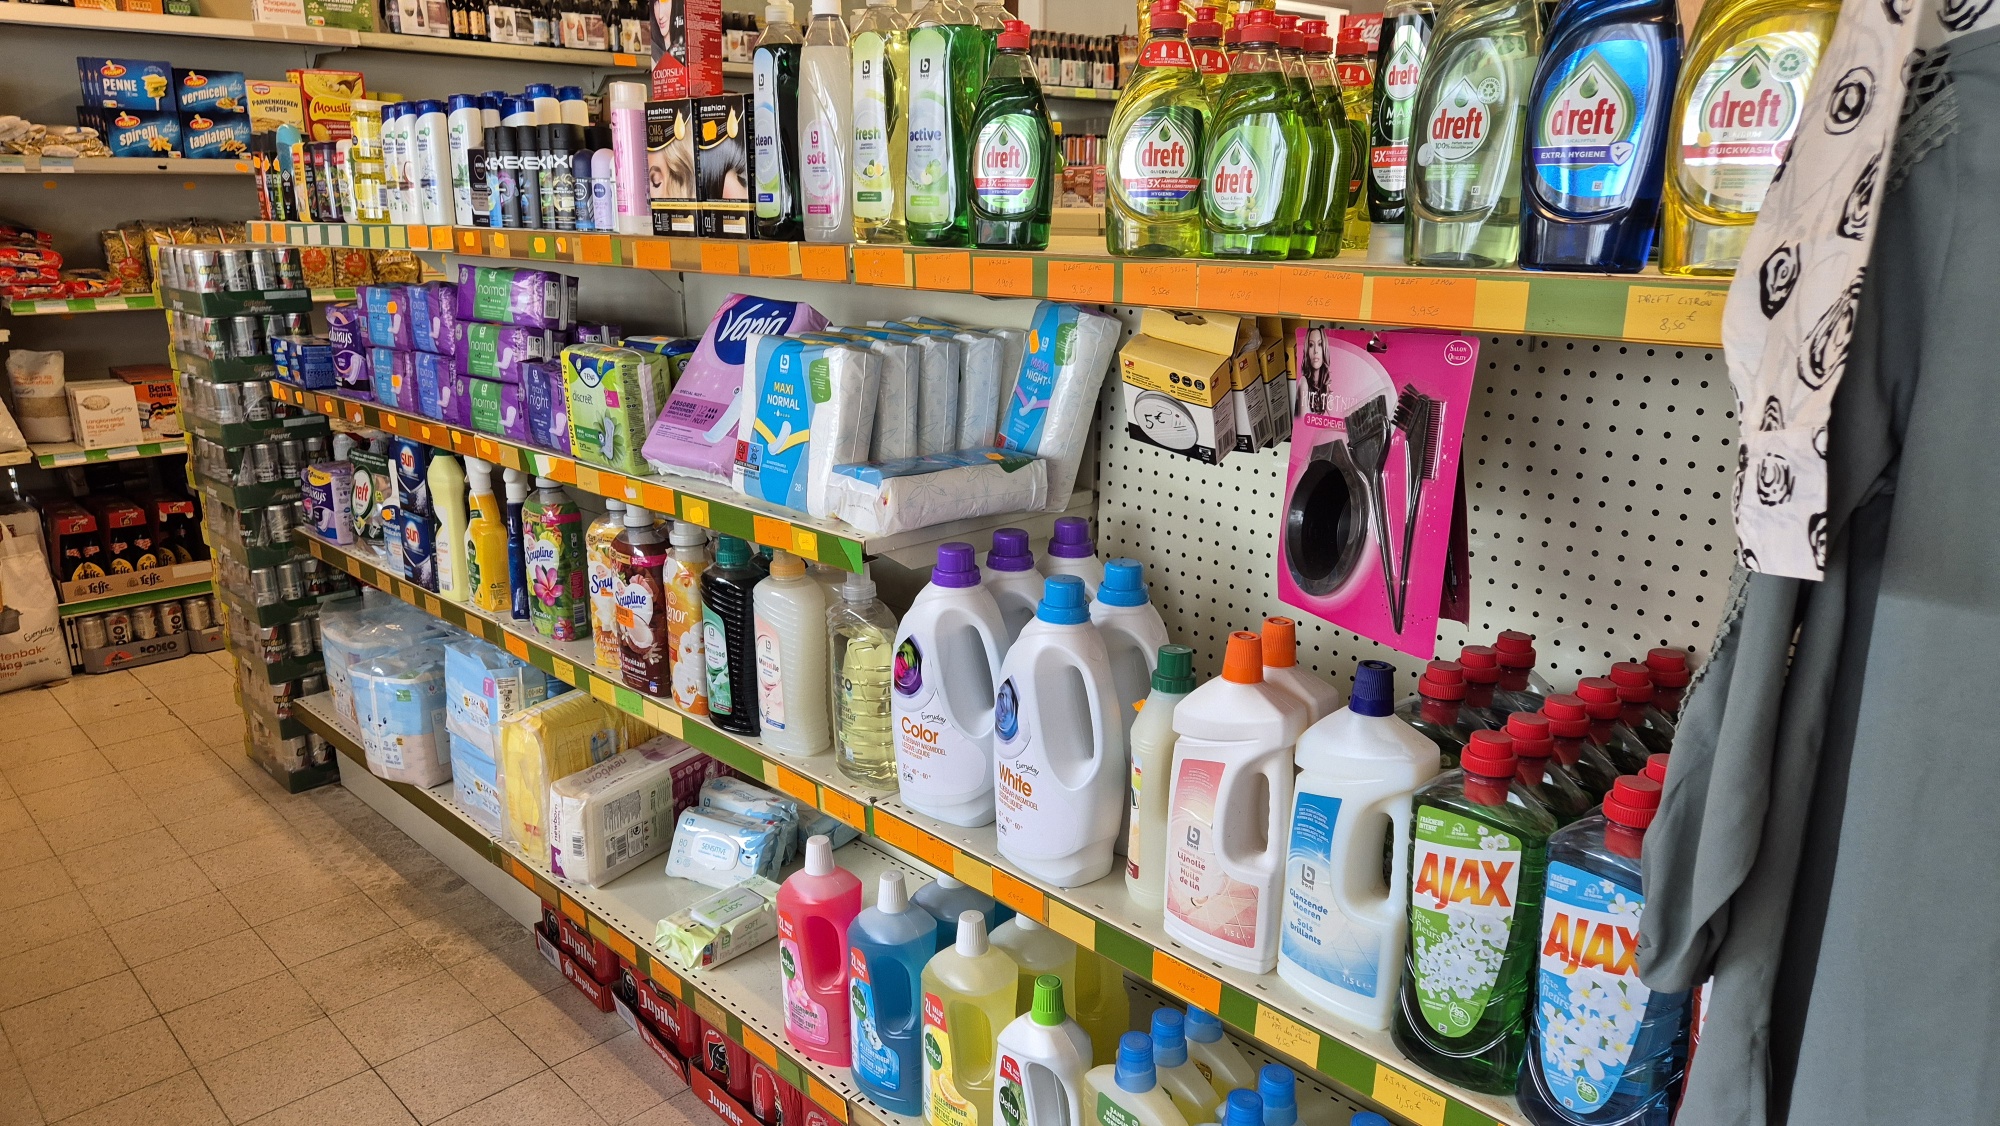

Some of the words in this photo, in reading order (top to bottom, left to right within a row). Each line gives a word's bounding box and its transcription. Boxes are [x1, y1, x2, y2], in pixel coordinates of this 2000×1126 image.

[654, 67, 684, 79] COLORSILK
[1388, 64, 1418, 86] dreft
[103, 78, 138, 92] PENNE
[182, 85, 228, 105] vermicelli
[252, 99, 299, 109] PANNENKOEKEN
[647, 107, 673, 116] fashion
[700, 104, 726, 113] fashion
[1709, 89, 1782, 129] dreft
[1432, 107, 1483, 140] dreft
[1551, 98, 1616, 136] dreft
[119, 125, 159, 147] spirelli
[855, 127, 881, 140] fresh
[910, 128, 942, 141] active
[807, 151, 827, 165] soft
[987, 145, 1021, 169] dreft
[1142, 141, 1185, 167] dreft
[1374, 150, 1386, 162] 5X
[1541, 151, 1566, 159] EXTRA
[1708, 147, 1772, 155] QUICKWASH
[1147, 179, 1162, 188] 3X
[1215, 166, 1253, 193] dreft
[1292, 268, 1318, 277] DREFT
[478, 283, 507, 297] normal
[1394, 278, 1422, 286] DREFT
[1307, 296, 1332, 307] 6,95€
[1637, 294, 1674, 303] DREFT
[1410, 306, 1440, 317] 3,95€
[717, 303, 789, 343] Vania
[471, 340, 495, 353] normal
[1030, 357, 1050, 373] MAXI
[583, 373, 596, 381] TENA
[1025, 369, 1048, 385] NIGHT
[148, 384, 172, 392] Ben's
[773, 382, 794, 395] MAXI
[473, 397, 498, 410] normal
[530, 394, 549, 410] night
[573, 390, 594, 405] discreet
[672, 400, 697, 410] ABSORBE
[766, 394, 800, 411] NORMAL
[699, 405, 708, 414] 12
[1144, 411, 1166, 430] 5€
[1306, 416, 1311, 424] 3
[1311, 417, 1323, 426] PCS
[401, 452, 414, 468] sun
[795, 483, 802, 492] 28
[405, 528, 420, 543] sun
[525, 547, 554, 564] Soupline
[632, 557, 639, 565] 30
[140, 572, 162, 586] Leffe
[88, 581, 111, 594] Leffe
[615, 591, 647, 609] Soupline
[24, 626, 55, 643] Everyday
[140, 641, 177, 653] RODEO
[759, 657, 780, 673] Marseille
[921, 712, 947, 726] Everyday
[901, 716, 939, 744] Color
[584, 758, 627, 785] newborn
[1016, 760, 1040, 776] Everyday
[999, 761, 1032, 797] White
[679, 839, 687, 847] 80
[702, 843, 726, 856] SENSITIVE
[1186, 841, 1199, 850] boni
[1177, 851, 1206, 871] Lijnolie
[1180, 868, 1200, 883] Huile
[1415, 852, 1515, 910] AJAX
[1179, 876, 1188, 886] de
[1189, 880, 1200, 892] lin
[1301, 881, 1314, 891] boni
[724, 902, 743, 913] SOFT
[1289, 888, 1328, 916] Glanzende
[1292, 901, 1321, 921] vloeren
[1414, 909, 1430, 925] fête
[745, 918, 758, 931] SOFT
[1297, 918, 1313, 933] Sols
[1416, 921, 1441, 942] fleurs
[1224, 928, 1235, 938] 1,5
[1290, 921, 1322, 946] brillants
[562, 927, 598, 970] Jupiler
[1543, 912, 1640, 978] AJAX
[781, 954, 795, 973] Dettol
[850, 951, 857, 970] 2L
[572, 969, 599, 1000] Jupiler
[1342, 975, 1355, 985] 1,5
[852, 993, 866, 1014] Dettol
[1542, 985, 1570, 1010] fleurs
[640, 990, 681, 1037] Jupiler
[925, 997, 932, 1015] 2L
[932, 1005, 943, 1019] VALUE
[931, 1014, 942, 1026] PACK
[649, 1036, 680, 1072] Jupiler
[925, 1038, 942, 1064] Dettol
[707, 1088, 744, 1126] Jupiler
[934, 1093, 968, 1117] ALLESREINIGER
[999, 1093, 1019, 1121] Dettol
[1414, 1091, 1441, 1108] CITRON
[934, 1105, 964, 1126] NETTOIE-TOUT
[1109, 1106, 1125, 1121] SANS
